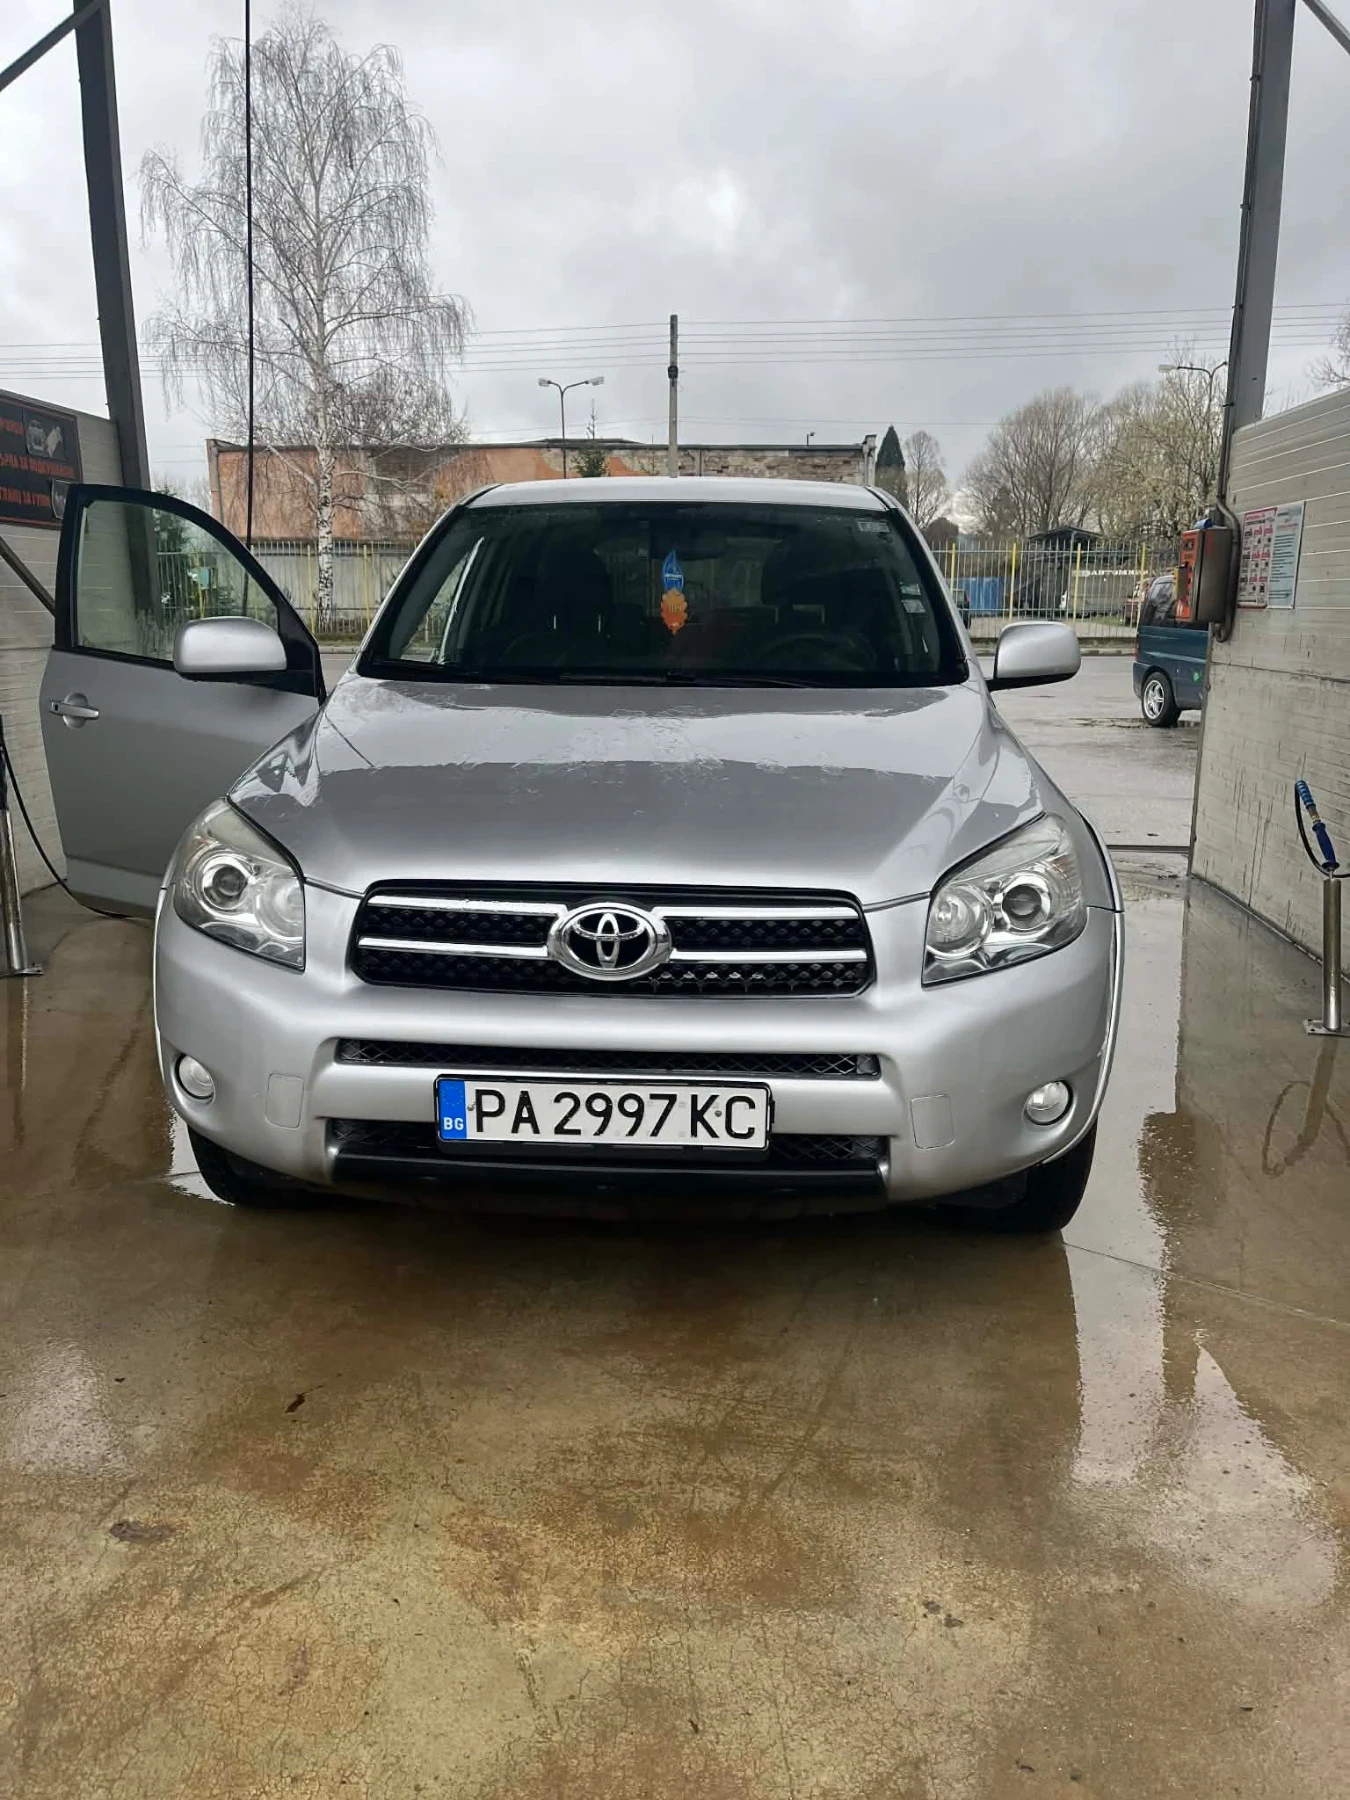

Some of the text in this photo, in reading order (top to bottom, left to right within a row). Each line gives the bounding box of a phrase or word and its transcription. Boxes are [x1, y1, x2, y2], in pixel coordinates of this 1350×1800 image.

[443, 1117, 464, 1130] BG
[475, 1089, 756, 1139] PA 2997 KC
